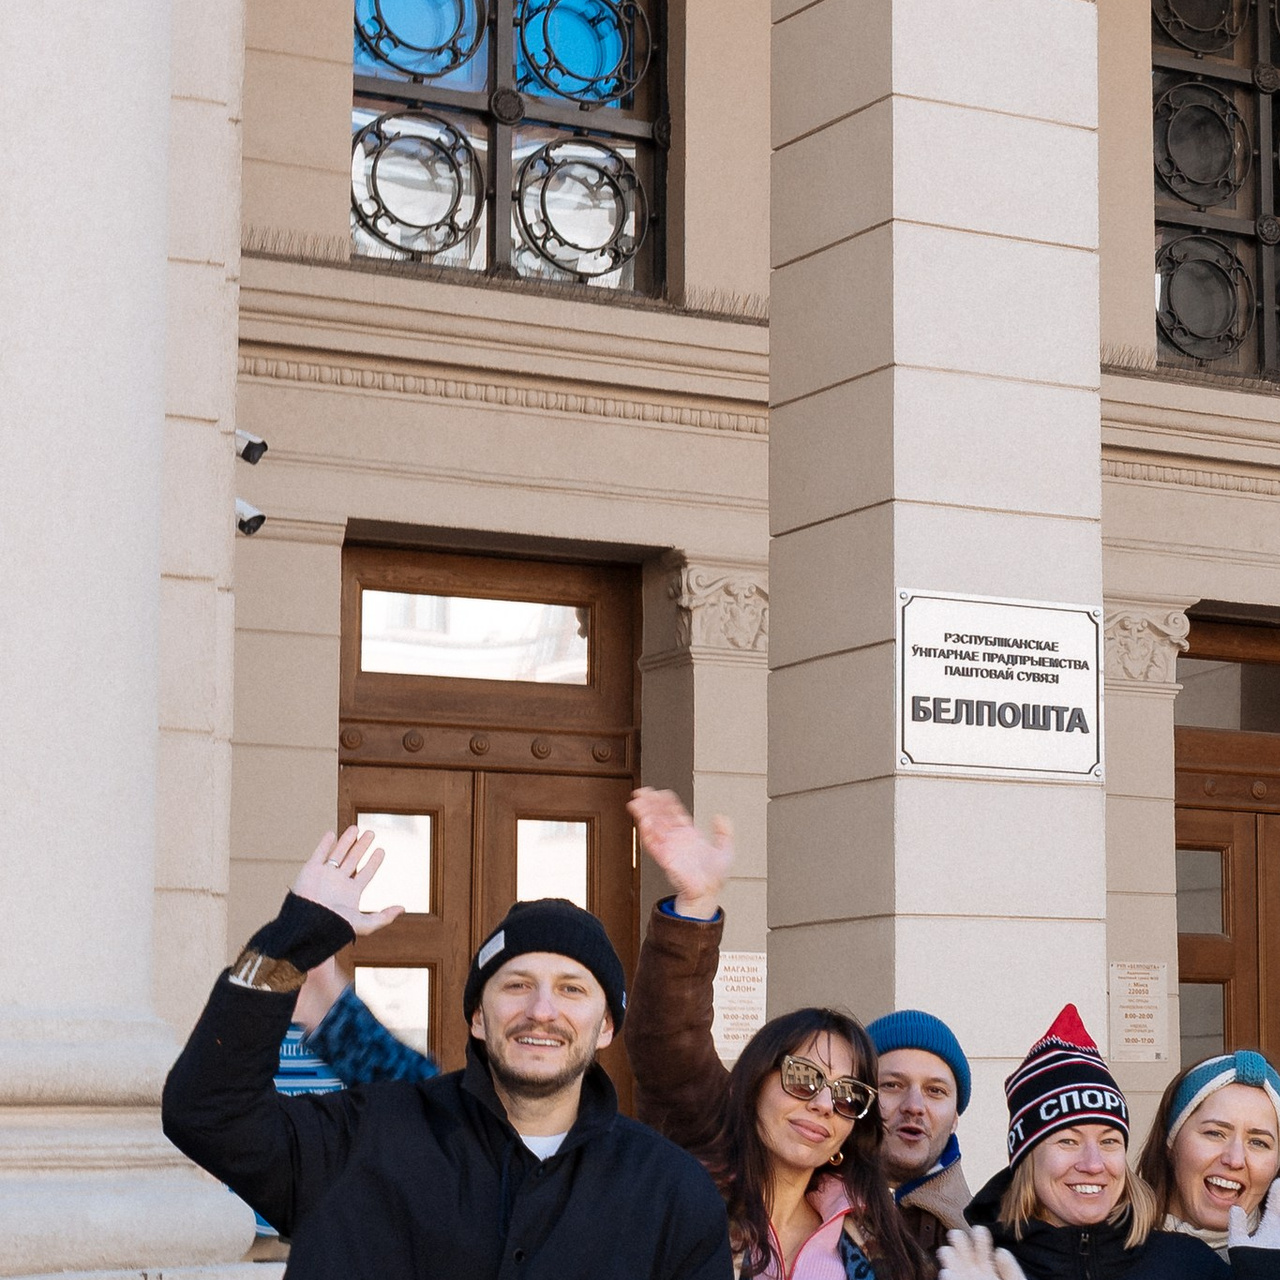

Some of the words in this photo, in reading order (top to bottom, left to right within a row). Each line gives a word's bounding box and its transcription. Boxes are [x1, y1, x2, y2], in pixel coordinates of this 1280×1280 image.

[944, 632, 1059, 652] РЭСПУБЛІКАНСКАЕ
[911, 644, 979, 662] ЎНІТАРНАЕ
[982, 652, 1090, 671] ПРАДПРЫЕМСТВА
[944, 665, 1014, 681] ПАШТОВАЙ
[1016, 673, 1059, 684] СУВЯЗІ
[911, 695, 1090, 734] БЕЛПОШТА
[723, 965, 758, 973] МАГАЗІН
[1039, 1089, 1127, 1121] СПОРТ
